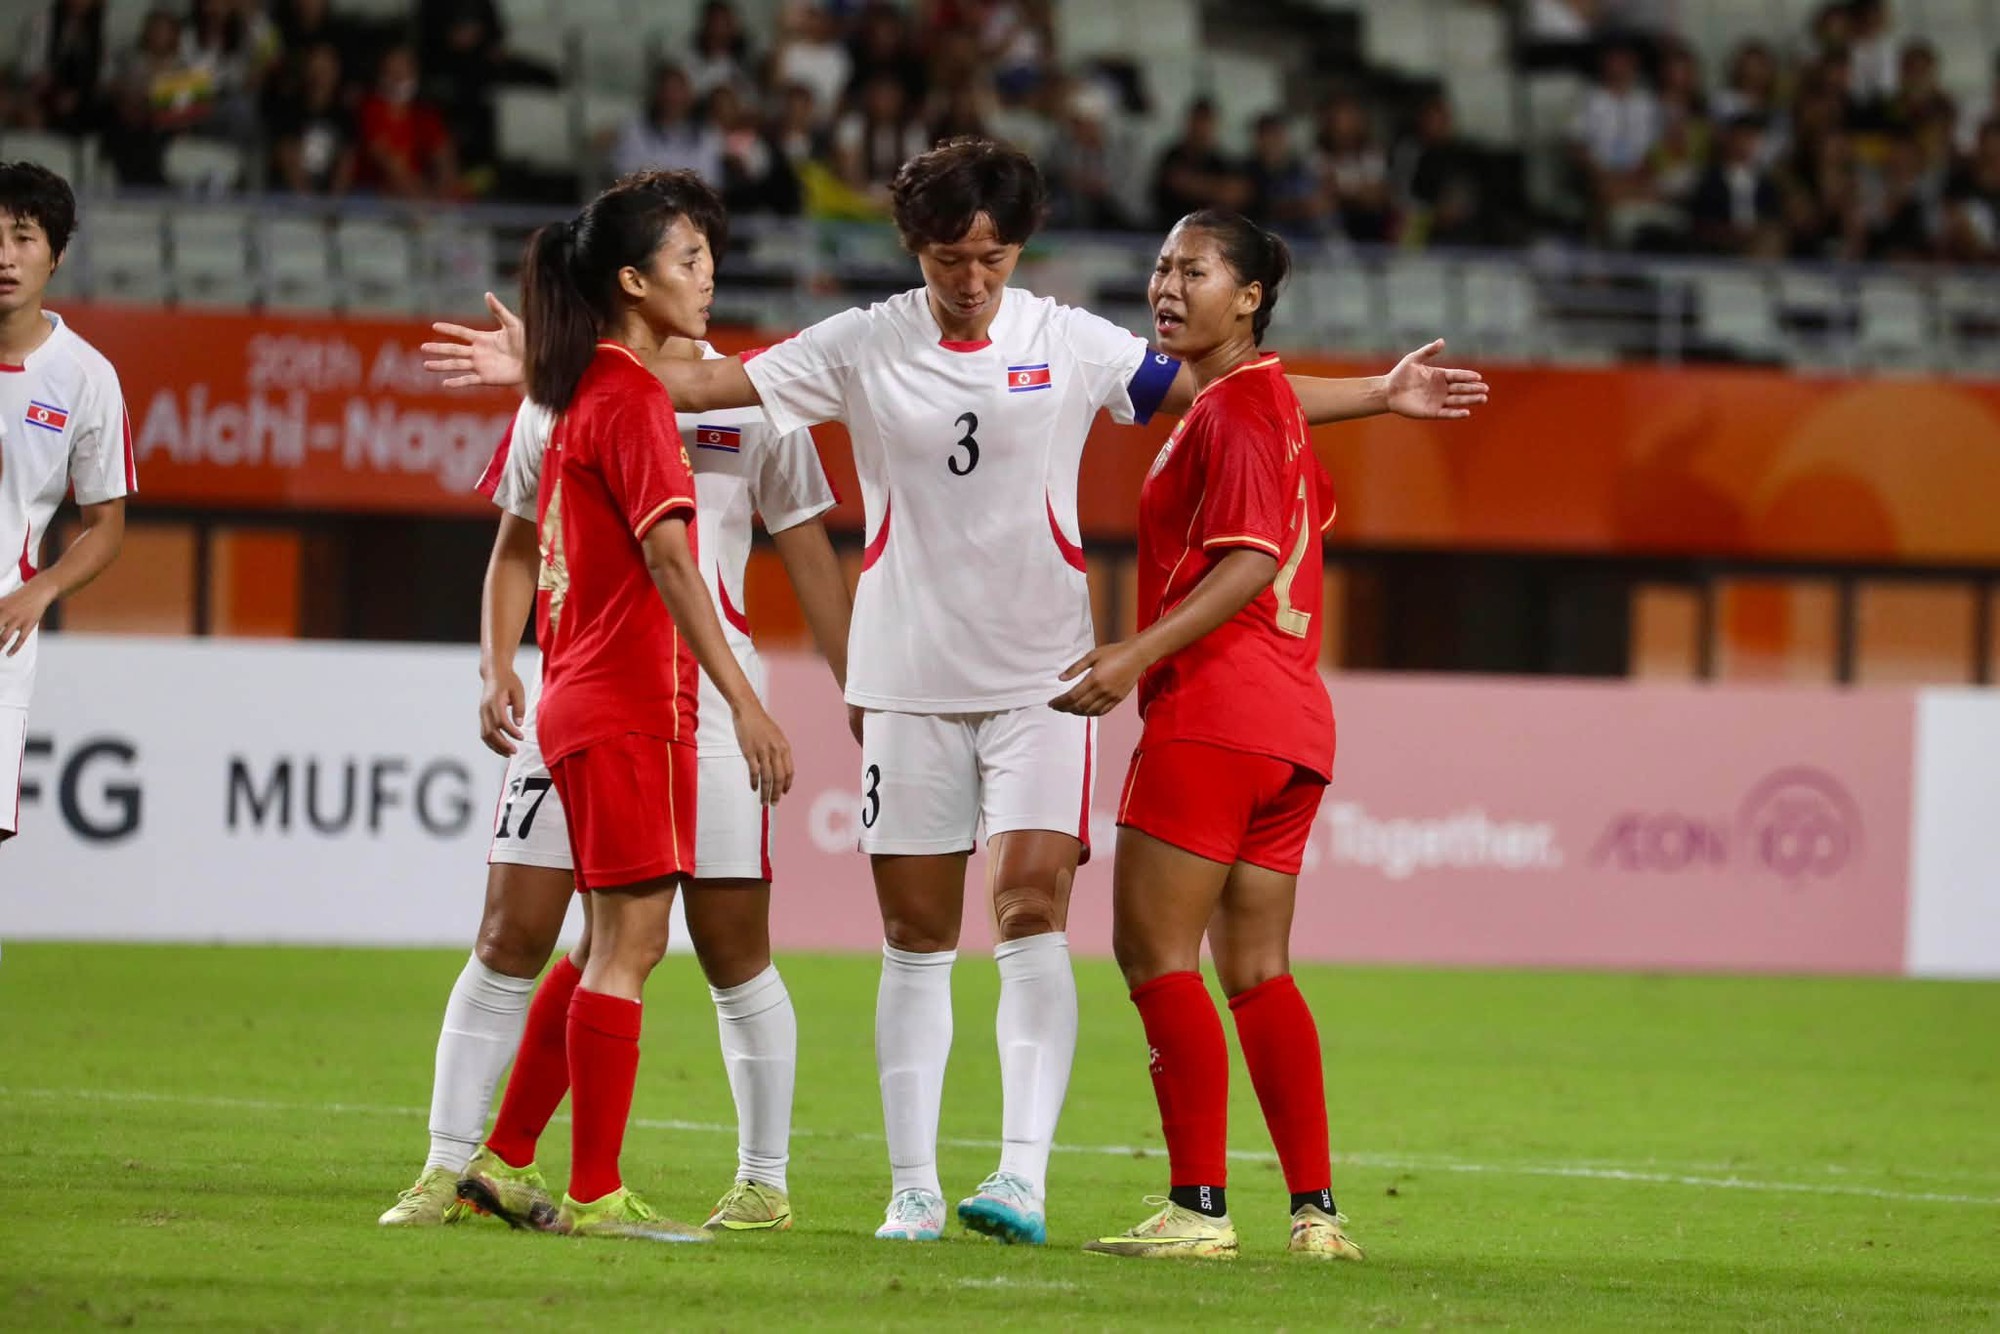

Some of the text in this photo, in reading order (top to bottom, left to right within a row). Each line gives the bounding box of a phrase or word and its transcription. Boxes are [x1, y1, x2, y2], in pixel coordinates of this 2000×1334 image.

[948, 411, 980, 477] 3
[1273, 474, 1312, 638] 2
[227, 756, 474, 839] MUFG
[496, 777, 554, 839] 17
[862, 764, 880, 828] 3
[1200, 1186, 1212, 1210] OCKS
